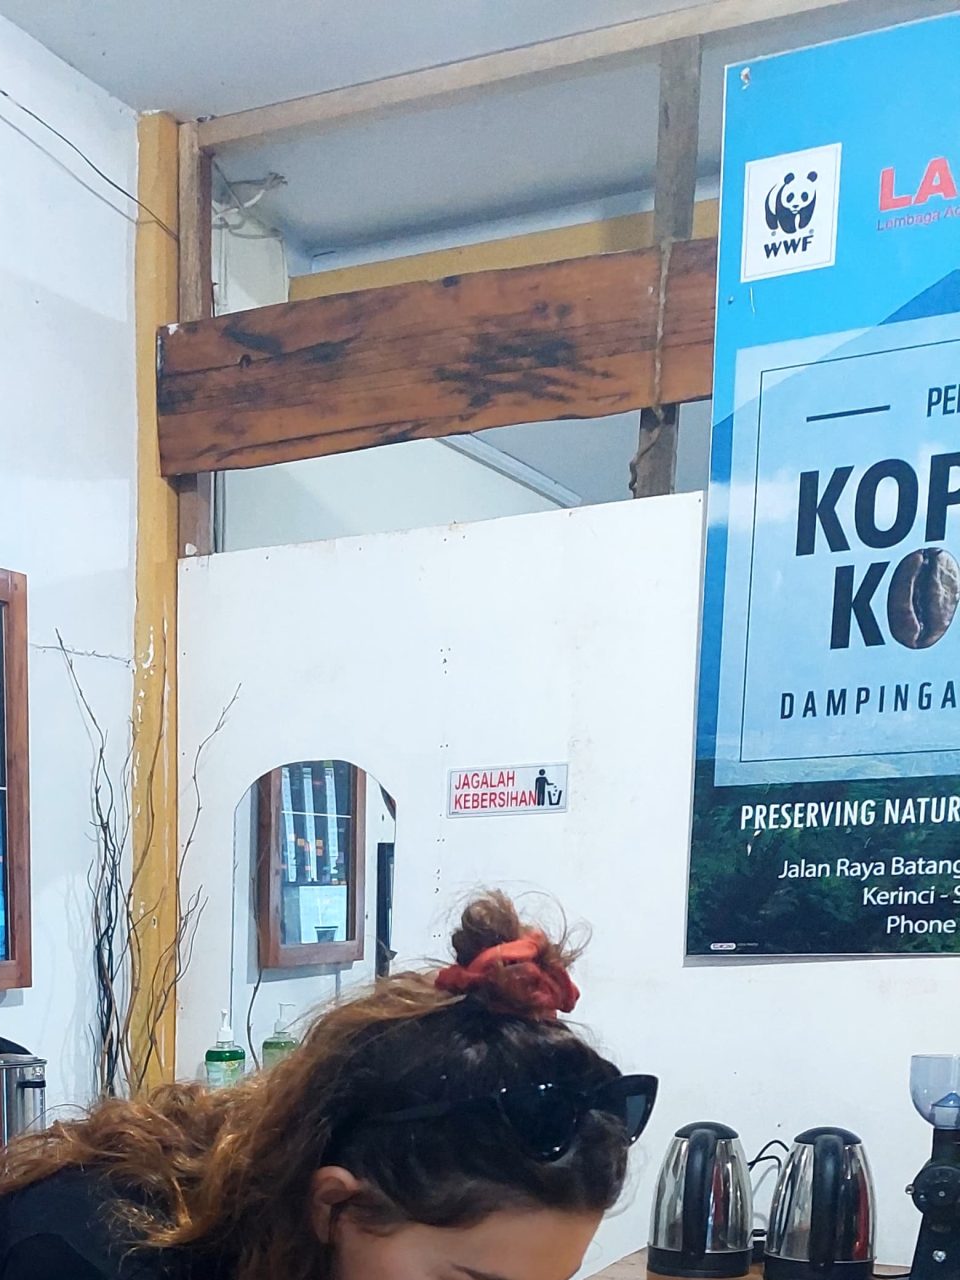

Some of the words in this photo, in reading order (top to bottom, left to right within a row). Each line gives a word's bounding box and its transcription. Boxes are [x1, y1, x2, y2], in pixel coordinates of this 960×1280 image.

[877, 209, 941, 231] Lembaga
[764, 234, 815, 259] WWF
[927, 383, 960, 418] PE
[780, 680, 957, 719] DAMPINGA
[455, 771, 515, 790] JAGALAH
[455, 790, 537, 809] KEBERSIHAN
[741, 799, 876, 831] PRESERVING
[778, 860, 831, 879] Jalan
[836, 858, 885, 881] Raya
[891, 856, 960, 879] Batang
[863, 886, 935, 906] Kerinci
[886, 914, 957, 935] Phone
